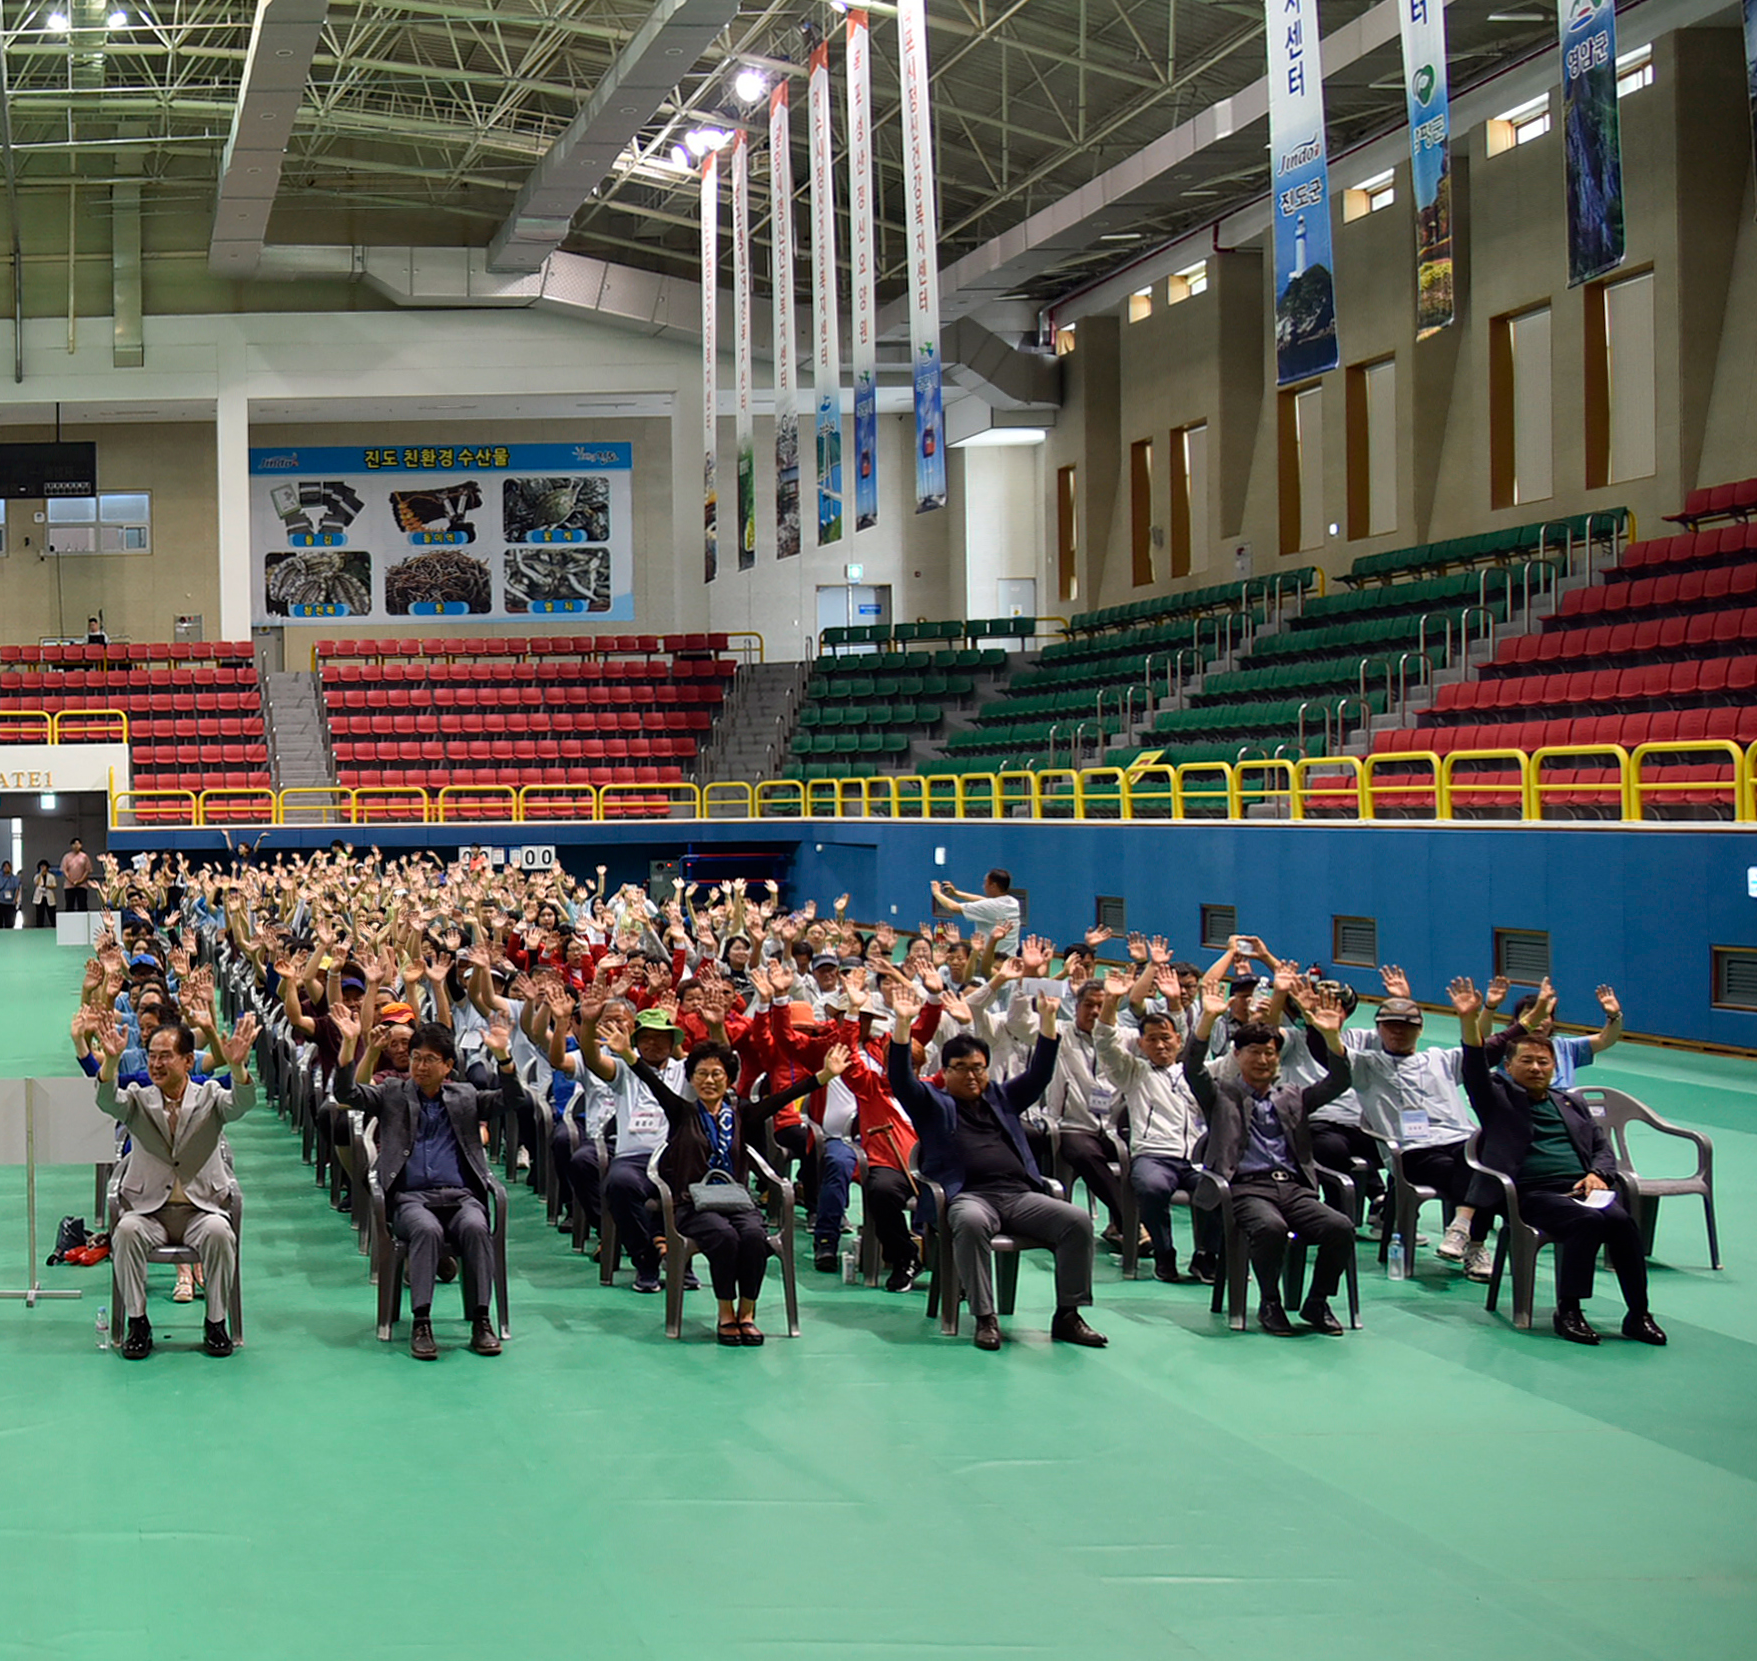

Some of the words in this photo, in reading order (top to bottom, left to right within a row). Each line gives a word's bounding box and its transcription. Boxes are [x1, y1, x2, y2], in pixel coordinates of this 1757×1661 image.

[1567, 30, 1608, 79] 영암군
[1277, 144, 1317, 177] Jindo
[1279, 177, 1322, 217] 진도군
[364, 448, 399, 469] 진도
[403, 447, 454, 469] 친환경
[457, 446, 510, 467] 수산물
